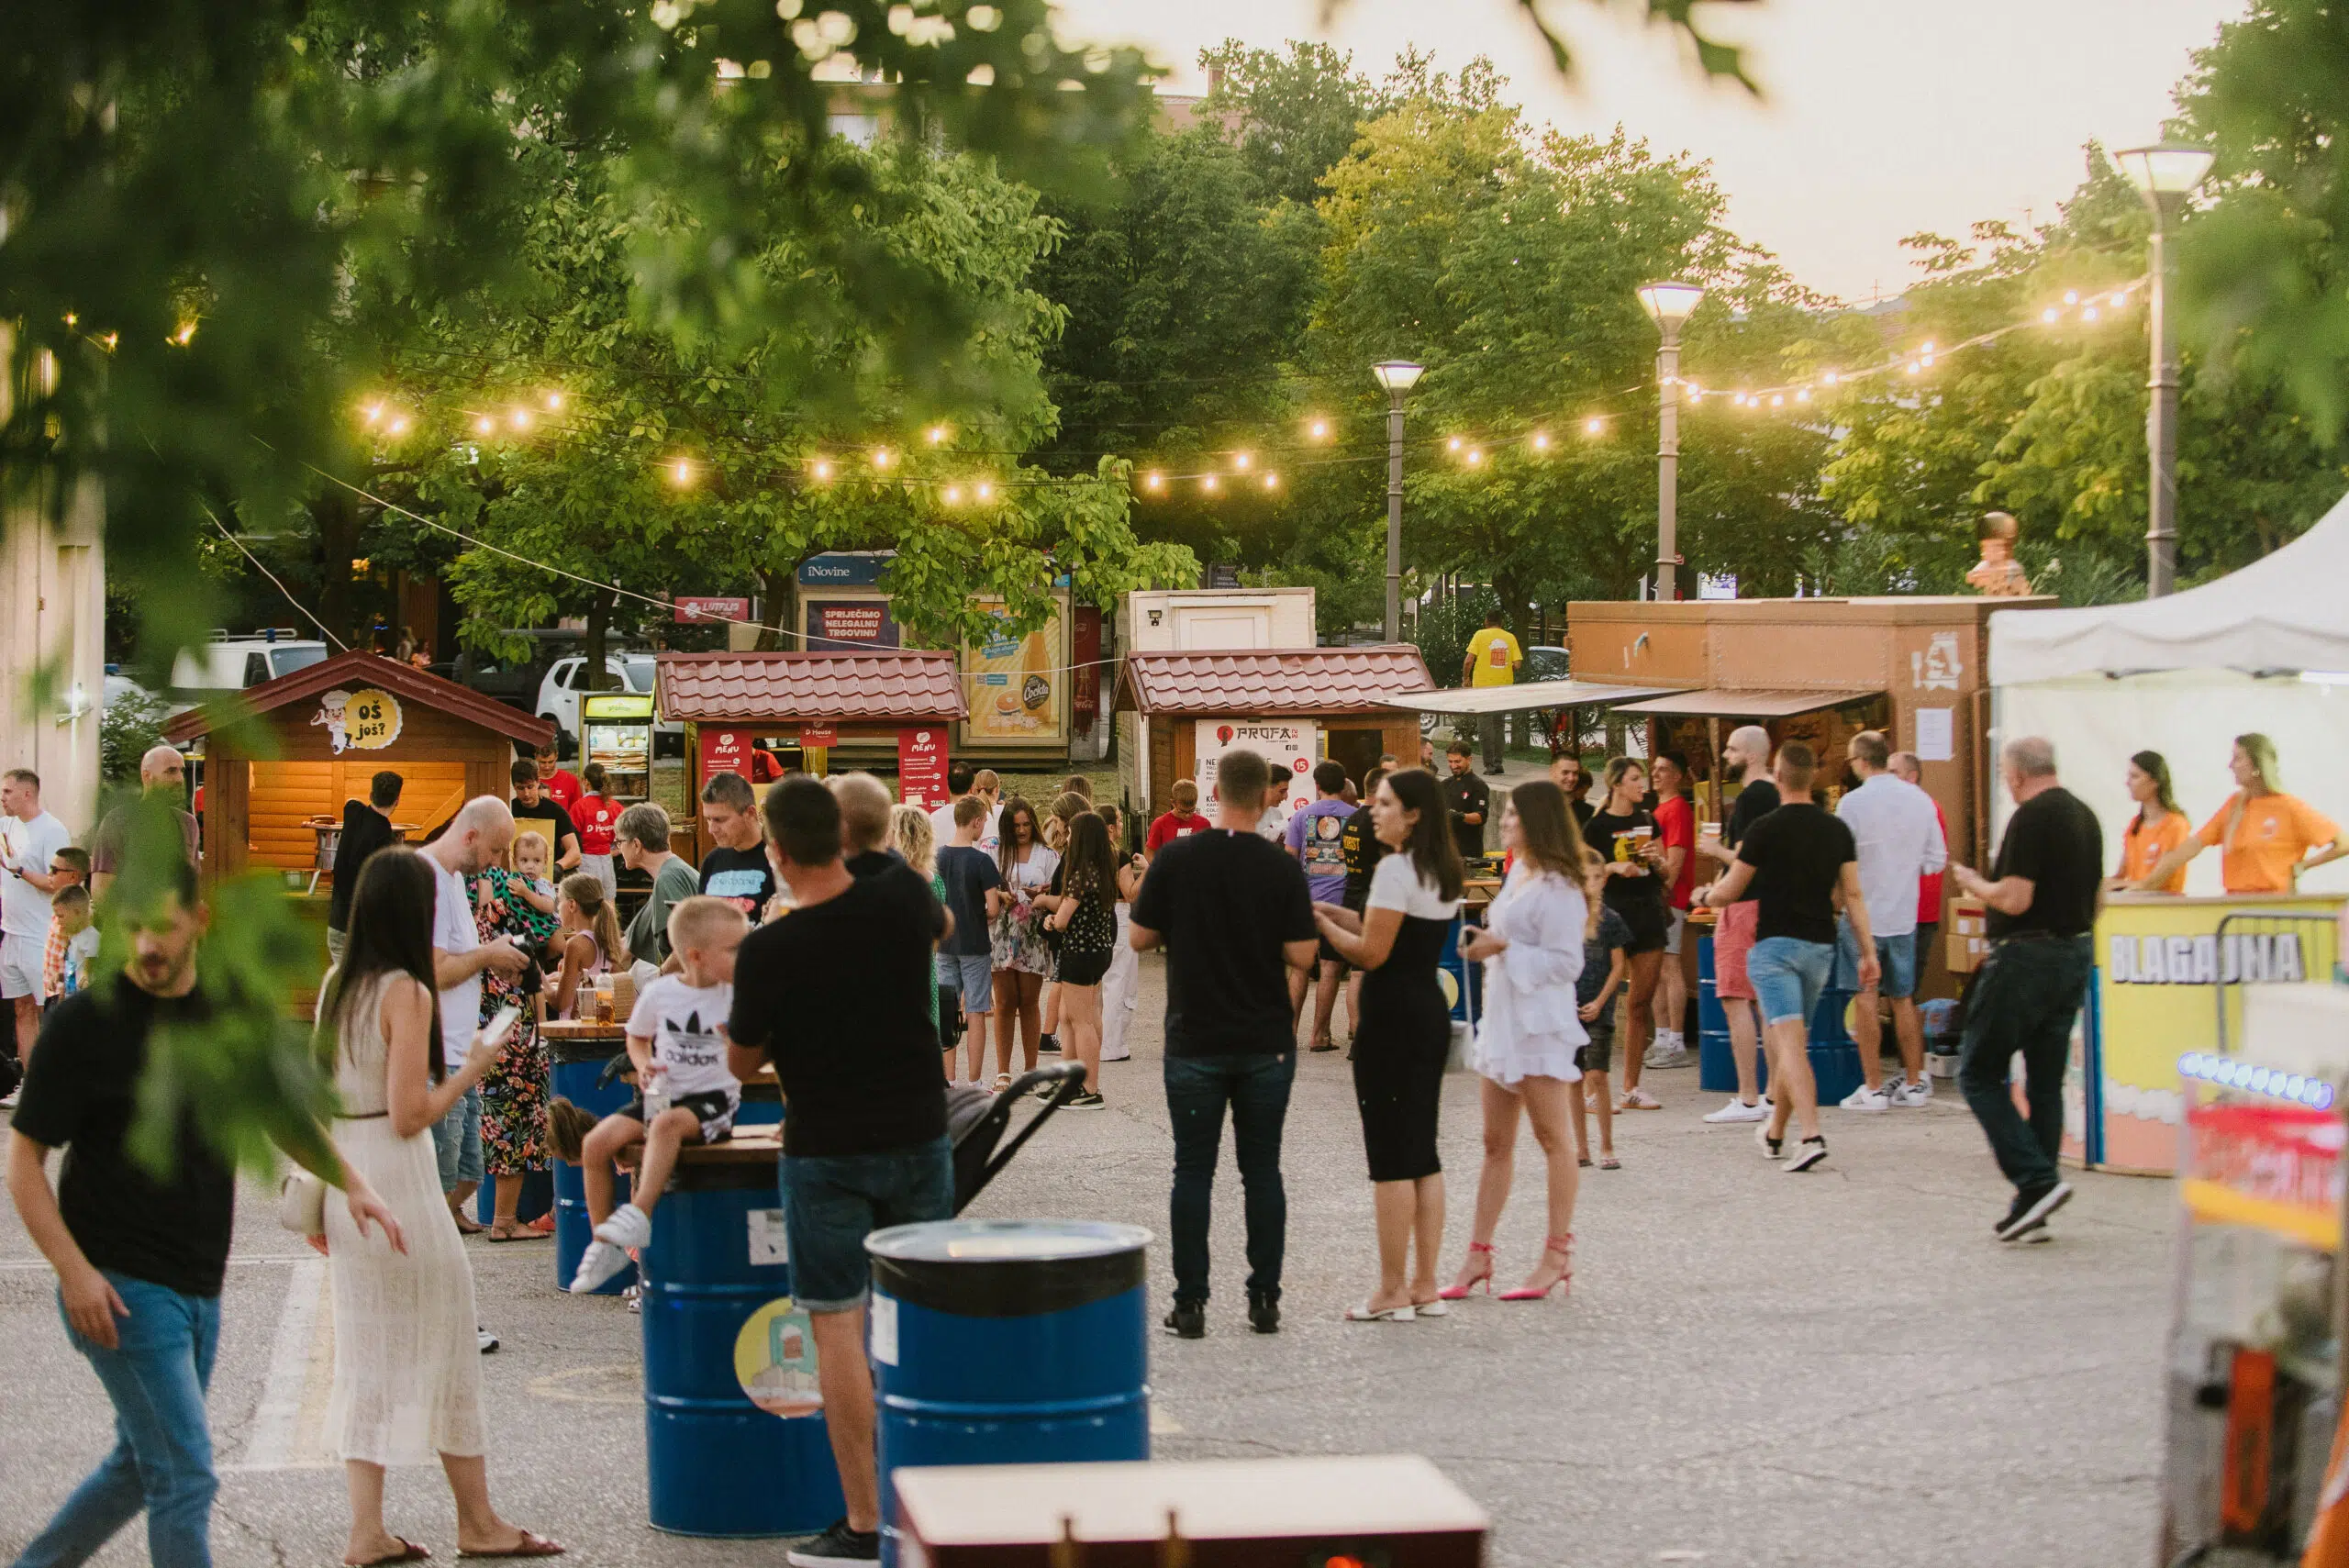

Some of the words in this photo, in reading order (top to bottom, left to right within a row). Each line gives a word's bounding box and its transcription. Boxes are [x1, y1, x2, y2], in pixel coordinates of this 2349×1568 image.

[807, 565, 851, 577] iNovine
[825, 609, 881, 618] SPRIJEČIMO
[828, 628, 877, 637] TRGOVINU
[1023, 684, 1049, 702] Cockta
[359, 699, 382, 719] OŠ
[355, 722, 385, 740] još?
[715, 745, 740, 754] MENU
[912, 743, 936, 752] MENU
[1296, 762, 1307, 770] 15
[587, 824, 593, 832] D
[1176, 828, 1193, 837] NIKE
[2110, 934, 2304, 984] BLAGAJNA
[666, 1050, 718, 1065] adidas
